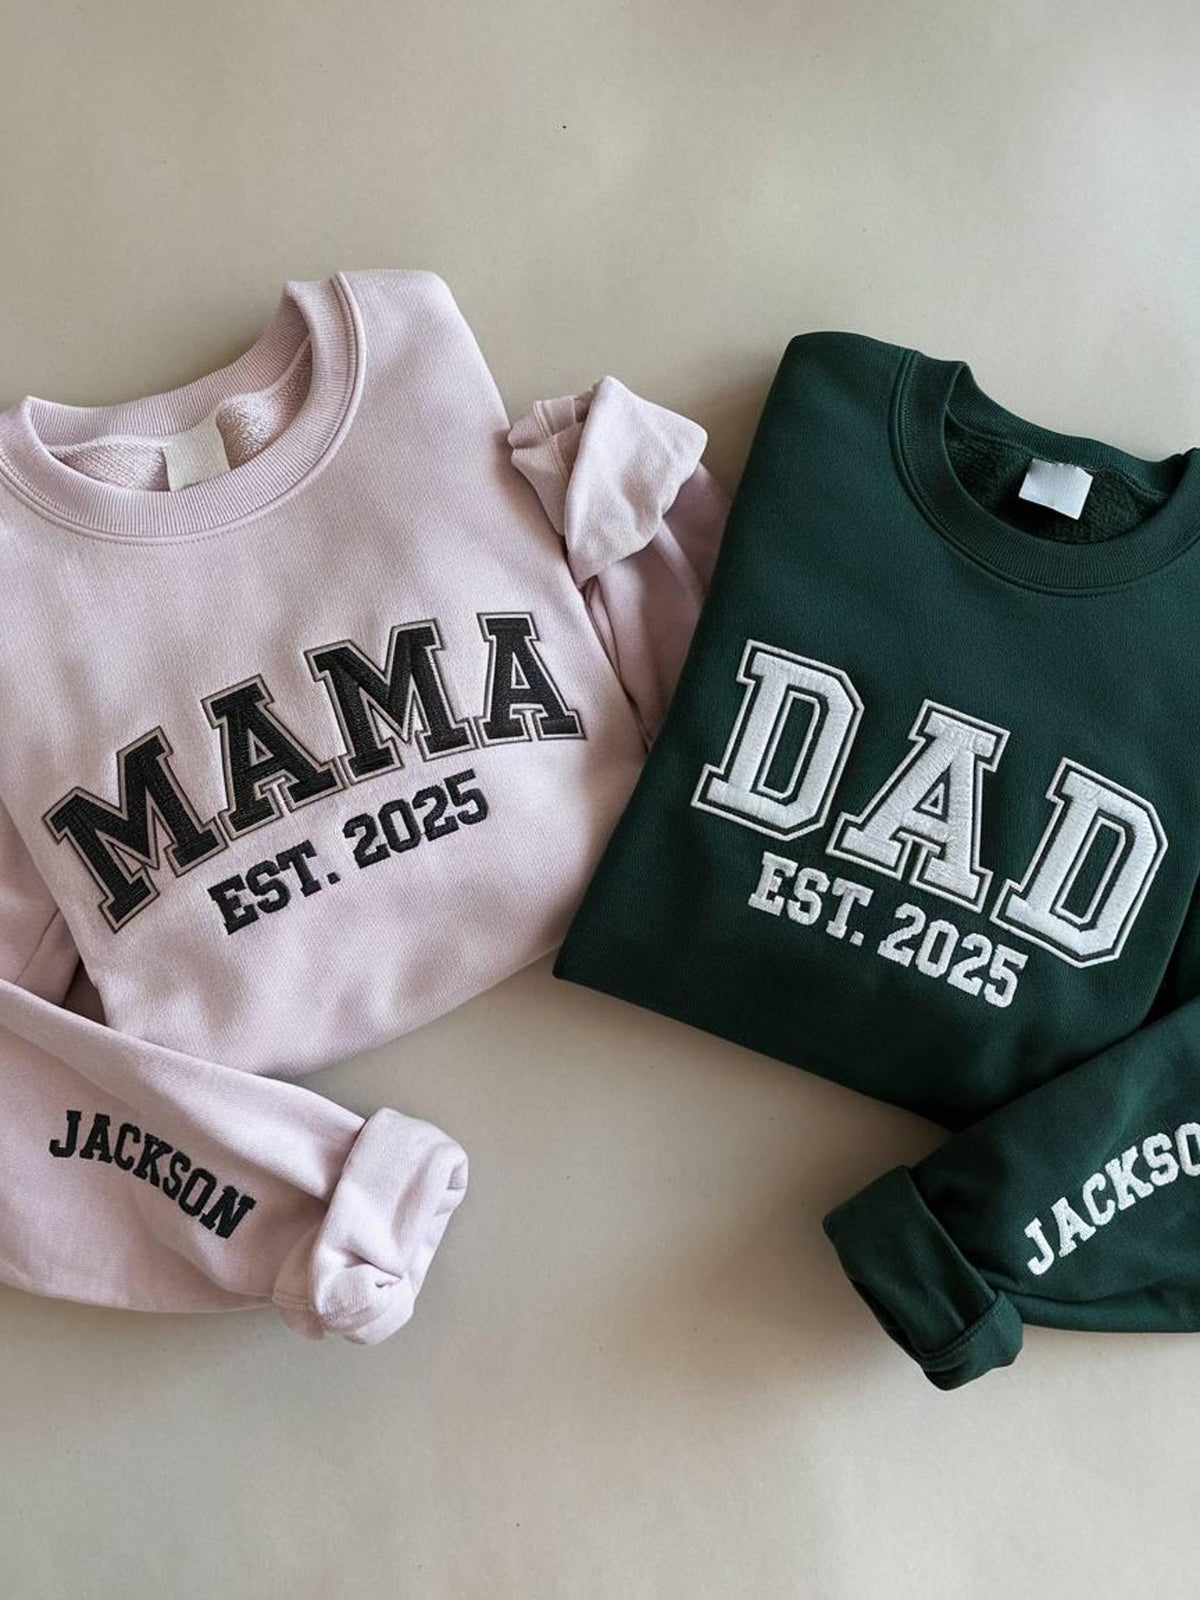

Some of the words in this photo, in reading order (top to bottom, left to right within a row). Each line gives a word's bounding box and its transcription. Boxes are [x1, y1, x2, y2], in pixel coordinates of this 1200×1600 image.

[41, 611, 588, 934] MAMA
[207, 840, 341, 935] EST.
[342, 768, 490, 869] 2025
[690, 639, 1169, 969] DAD
[748, 851, 874, 947] EST.
[877, 903, 1030, 1008] 2025
[48, 1109, 257, 1239] JACKSON
